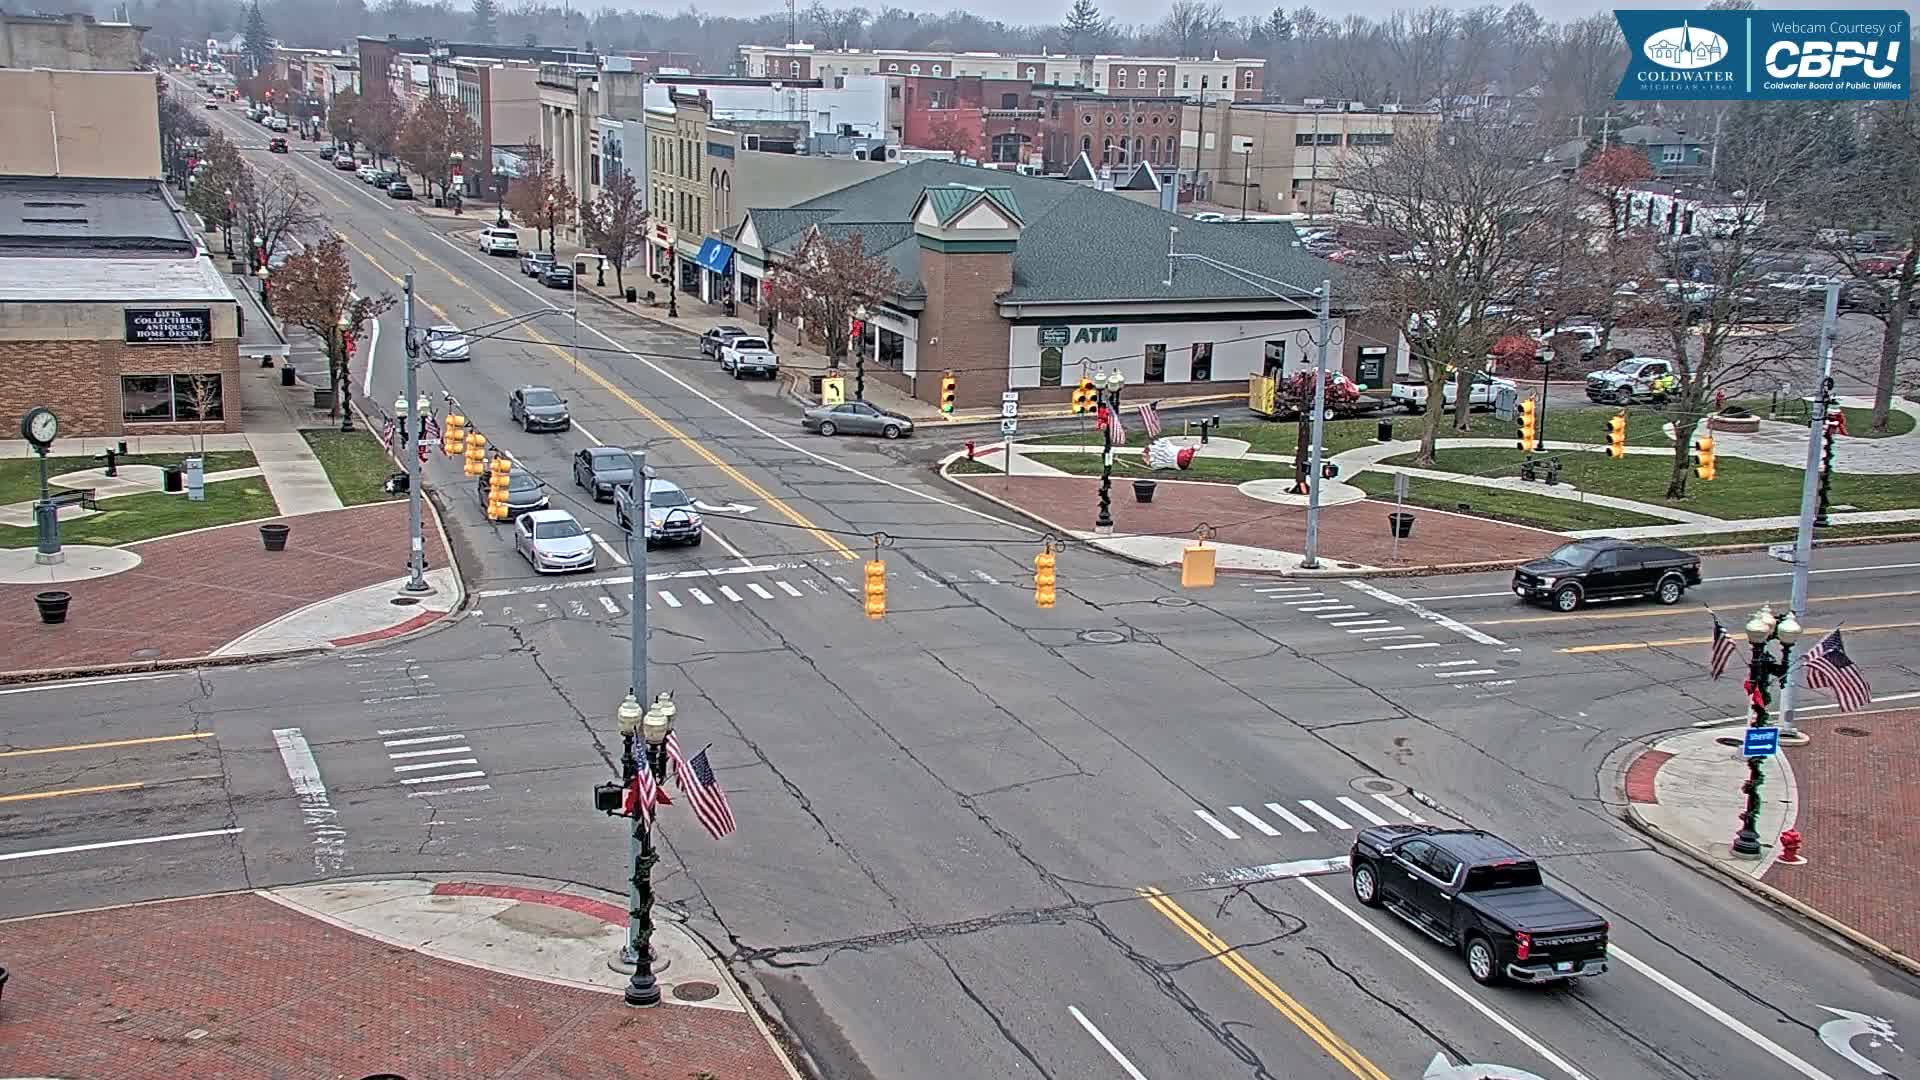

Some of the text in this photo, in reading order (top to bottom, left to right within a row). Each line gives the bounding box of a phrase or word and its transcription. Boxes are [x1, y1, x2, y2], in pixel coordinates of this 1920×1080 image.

[1073, 327, 1118, 343] ATM
[1005, 405, 1015, 414] 12
[1535, 935, 1600, 946] CHEVROLET
